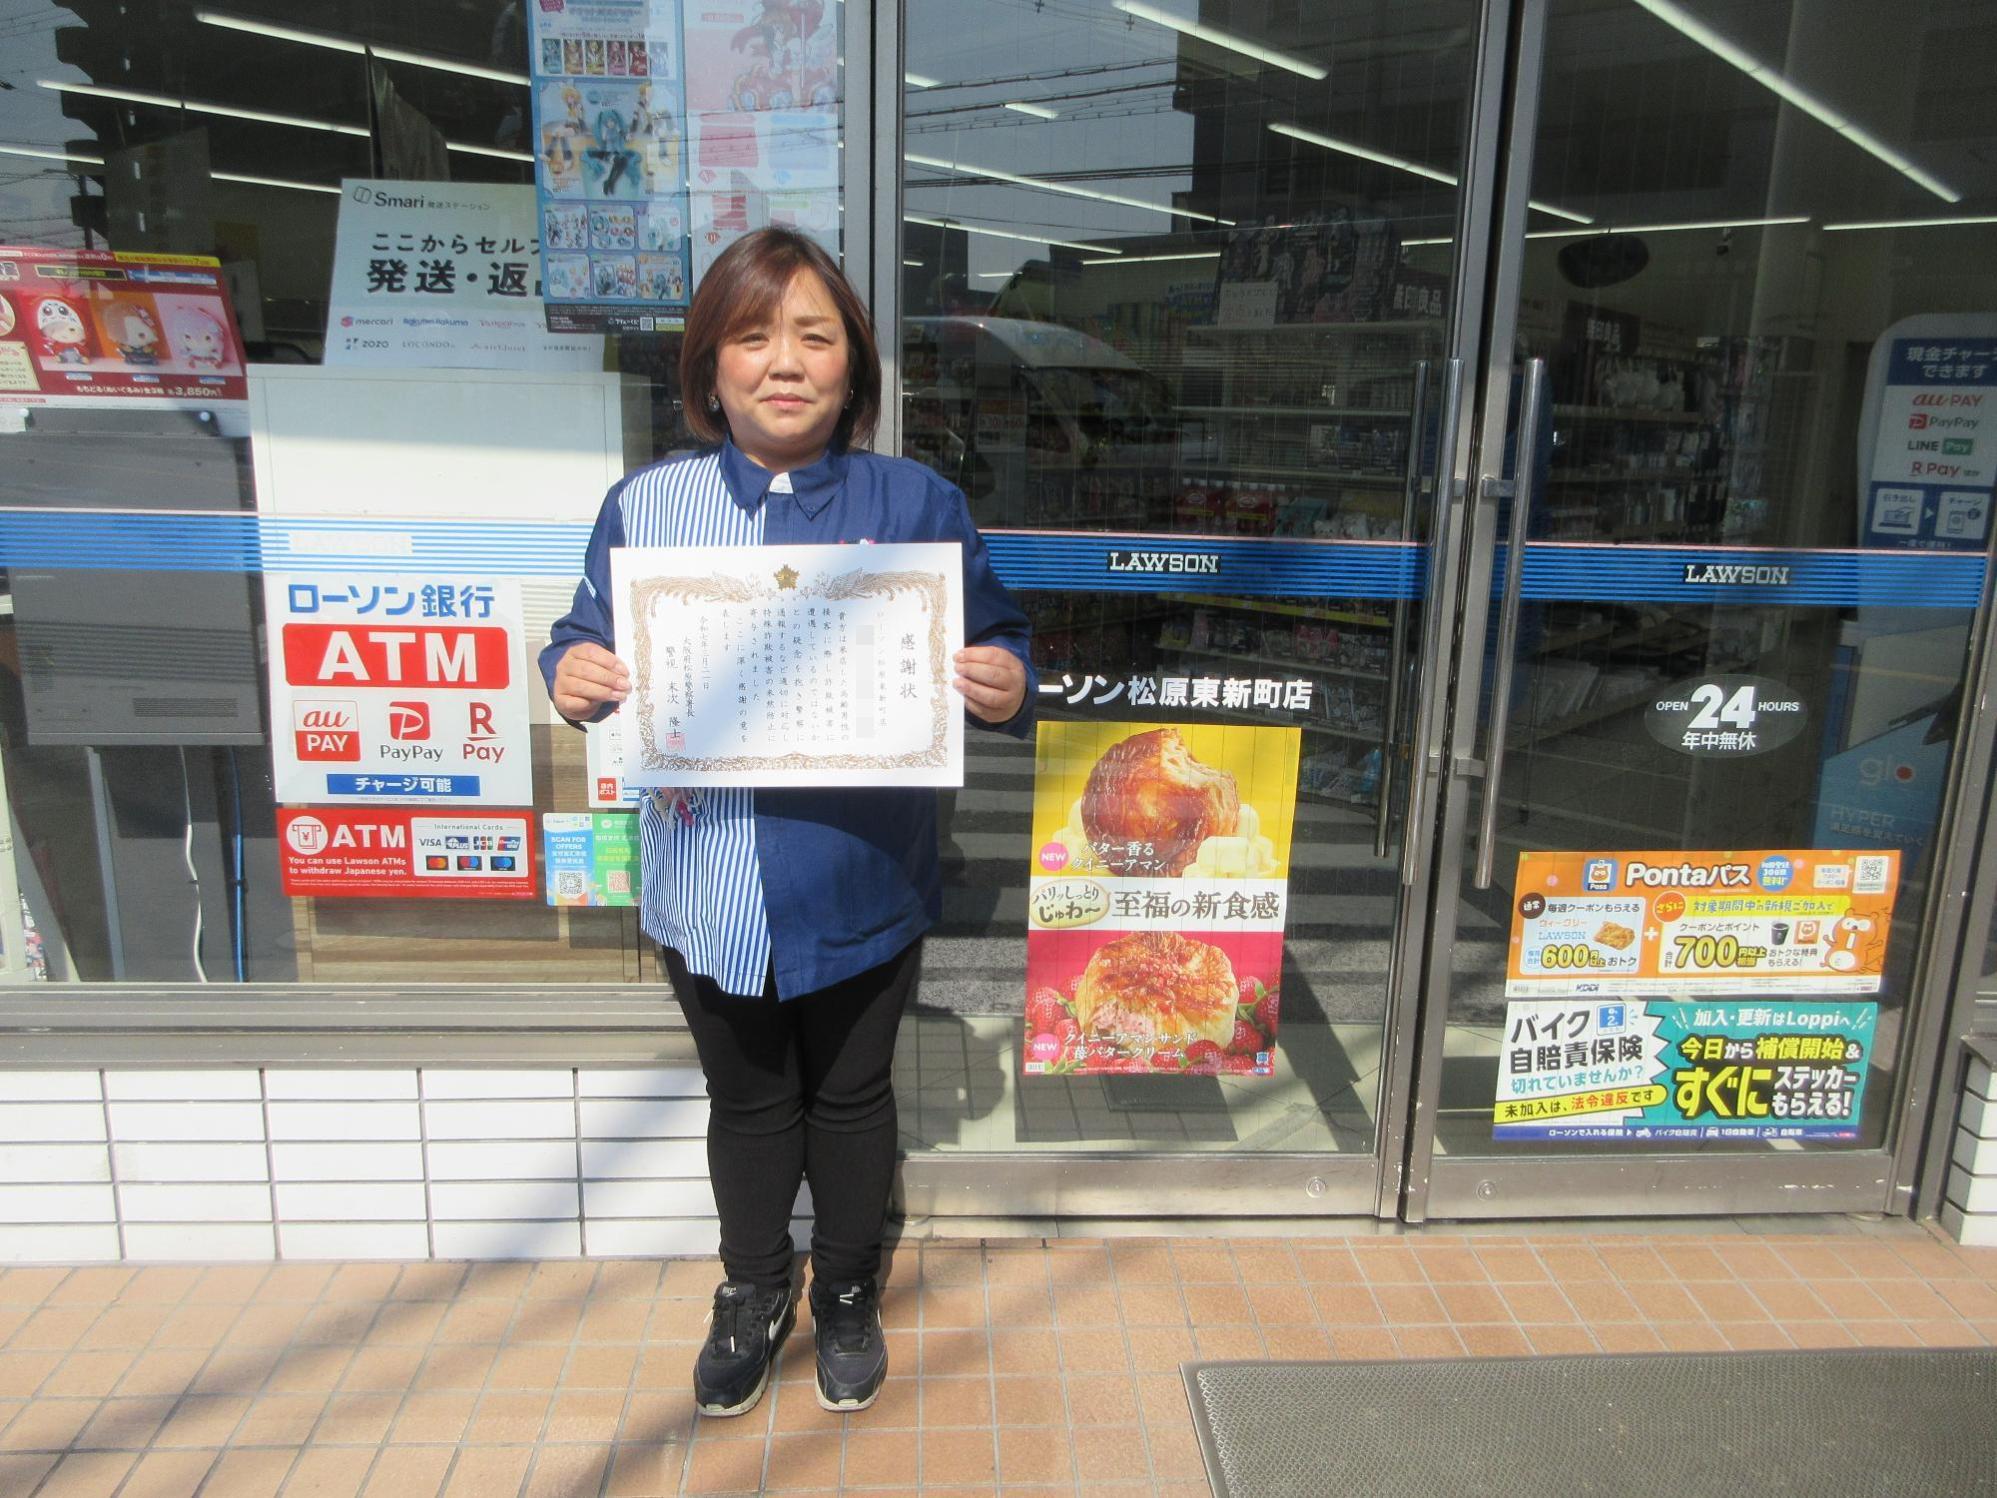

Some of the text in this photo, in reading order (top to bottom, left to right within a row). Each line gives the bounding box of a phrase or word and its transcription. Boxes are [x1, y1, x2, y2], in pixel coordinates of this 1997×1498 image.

[374, 192, 424, 209] Smari
[367, 259, 543, 297] 発送・返
[1922, 364, 1988, 379] できます
[1912, 394, 1984, 406] au PAY
[1929, 417, 1980, 430] PayPay
[1907, 440, 1940, 451] LINE
[1927, 462, 1960, 477] Pay
[1109, 552, 1218, 573] LAWSON
[1685, 564, 1789, 585] LAWSON
[288, 584, 495, 617] ローソン銀行
[317, 631, 477, 682] ATM
[900, 632, 918, 699] 感謝状
[1656, 683, 1799, 729] OPEN 24 HOURS
[303, 710, 350, 728] au
[469, 702, 496, 735] R
[307, 734, 348, 752] PAY
[1681, 732, 1756, 750] 年中無休
[380, 745, 443, 762] PayPay
[463, 744, 505, 764] Pay
[355, 777, 452, 793] チャージ可能
[1831, 806, 1896, 828] HYPER
[332, 824, 406, 848] ATM
[419, 838, 442, 847] VISA
[288, 857, 305, 865] You
[343, 857, 380, 865] Lawson
[382, 858, 406, 866] ATMs
[1041, 853, 1065, 861] NEW
[1072, 859, 1166, 871] クイニーアマン
[301, 867, 342, 875] withdraw
[344, 868, 386, 877] Japanese
[388, 868, 407, 877] yen.
[1626, 861, 1750, 887] Pontaパス
[1112, 890, 1280, 920] 至福の新食感
[1548, 903, 1640, 913] 毎週クーポンもらえる
[1656, 901, 1683, 913] さらに
[1539, 931, 1586, 941] LAWSON
[1680, 923, 1760, 932] クーポンとポイント
[1511, 1010, 1590, 1043] バイク
[1693, 1008, 1852, 1030] 加入・更新はLoppiへ
[1033, 1042, 1058, 1052] NEW
[1510, 1034, 1643, 1074] 自賠責保険
[1680, 1037, 1861, 1061] 今日から補償開始&
[1511, 1065, 1643, 1094] 切れていませんか?
[1774, 1065, 1857, 1089] ステッカー
[1675, 1066, 1772, 1117] すぐに
[1505, 1090, 1654, 1118] 未加入は、法令違反です
[1772, 1091, 1851, 1117] もらえる!
[1549, 1128, 1623, 1137] ローソンで入れる保険
